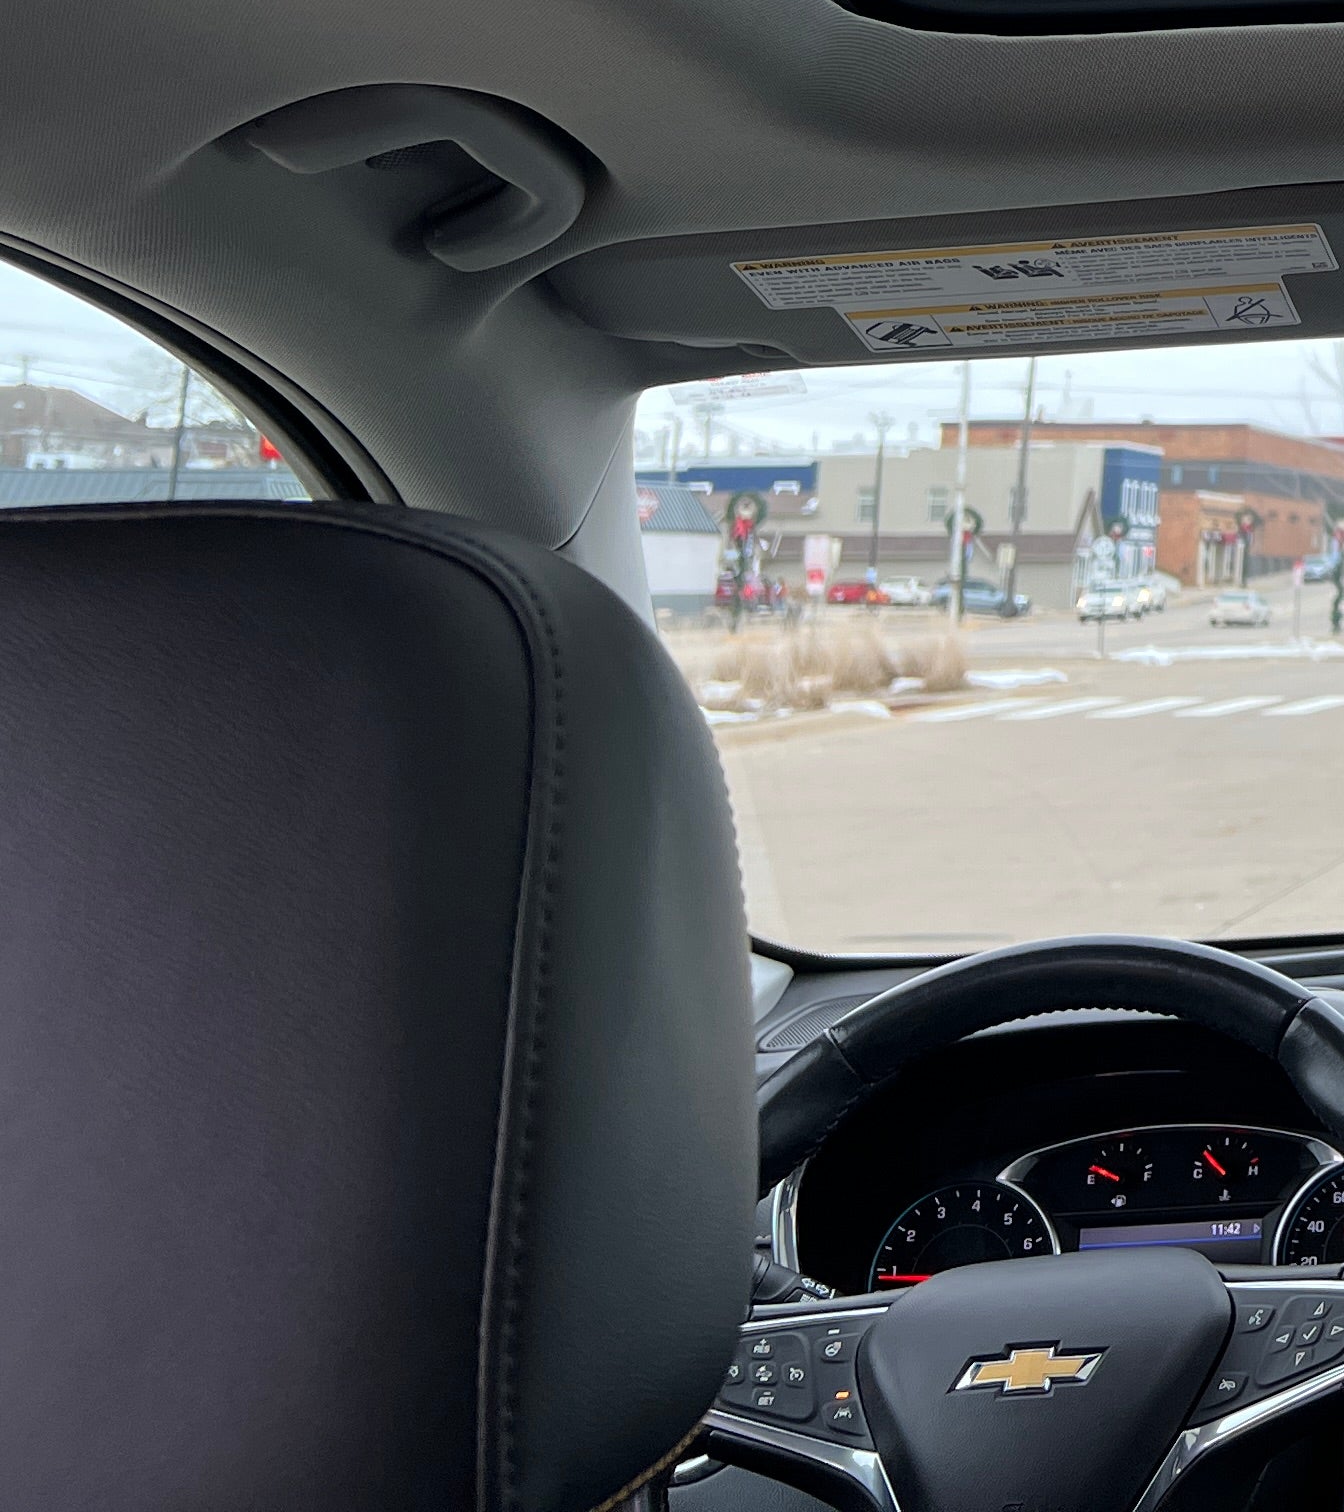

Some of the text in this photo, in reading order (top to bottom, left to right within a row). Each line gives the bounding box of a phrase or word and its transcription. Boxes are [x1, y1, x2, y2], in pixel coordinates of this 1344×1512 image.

[760, 259, 826, 269] WARNING
[1143, 1171, 1152, 1182] F
[1193, 1168, 1203, 1179] C
[1248, 1165, 1259, 1176] H
[1087, 1174, 1096, 1185] E
[971, 1199, 981, 1212] 4
[937, 1206, 946, 1219] 3
[1003, 1212, 1013, 1225] 5
[1210, 1222, 1241, 1235] 11:42
[1306, 1220, 1325, 1233] 40
[906, 1229, 916, 1242] 2
[1023, 1238, 1033, 1250] 6
[1300, 1255, 1318, 1266] 20
[892, 1265, 897, 1277] 1
[757, 1396, 775, 1406] SET
